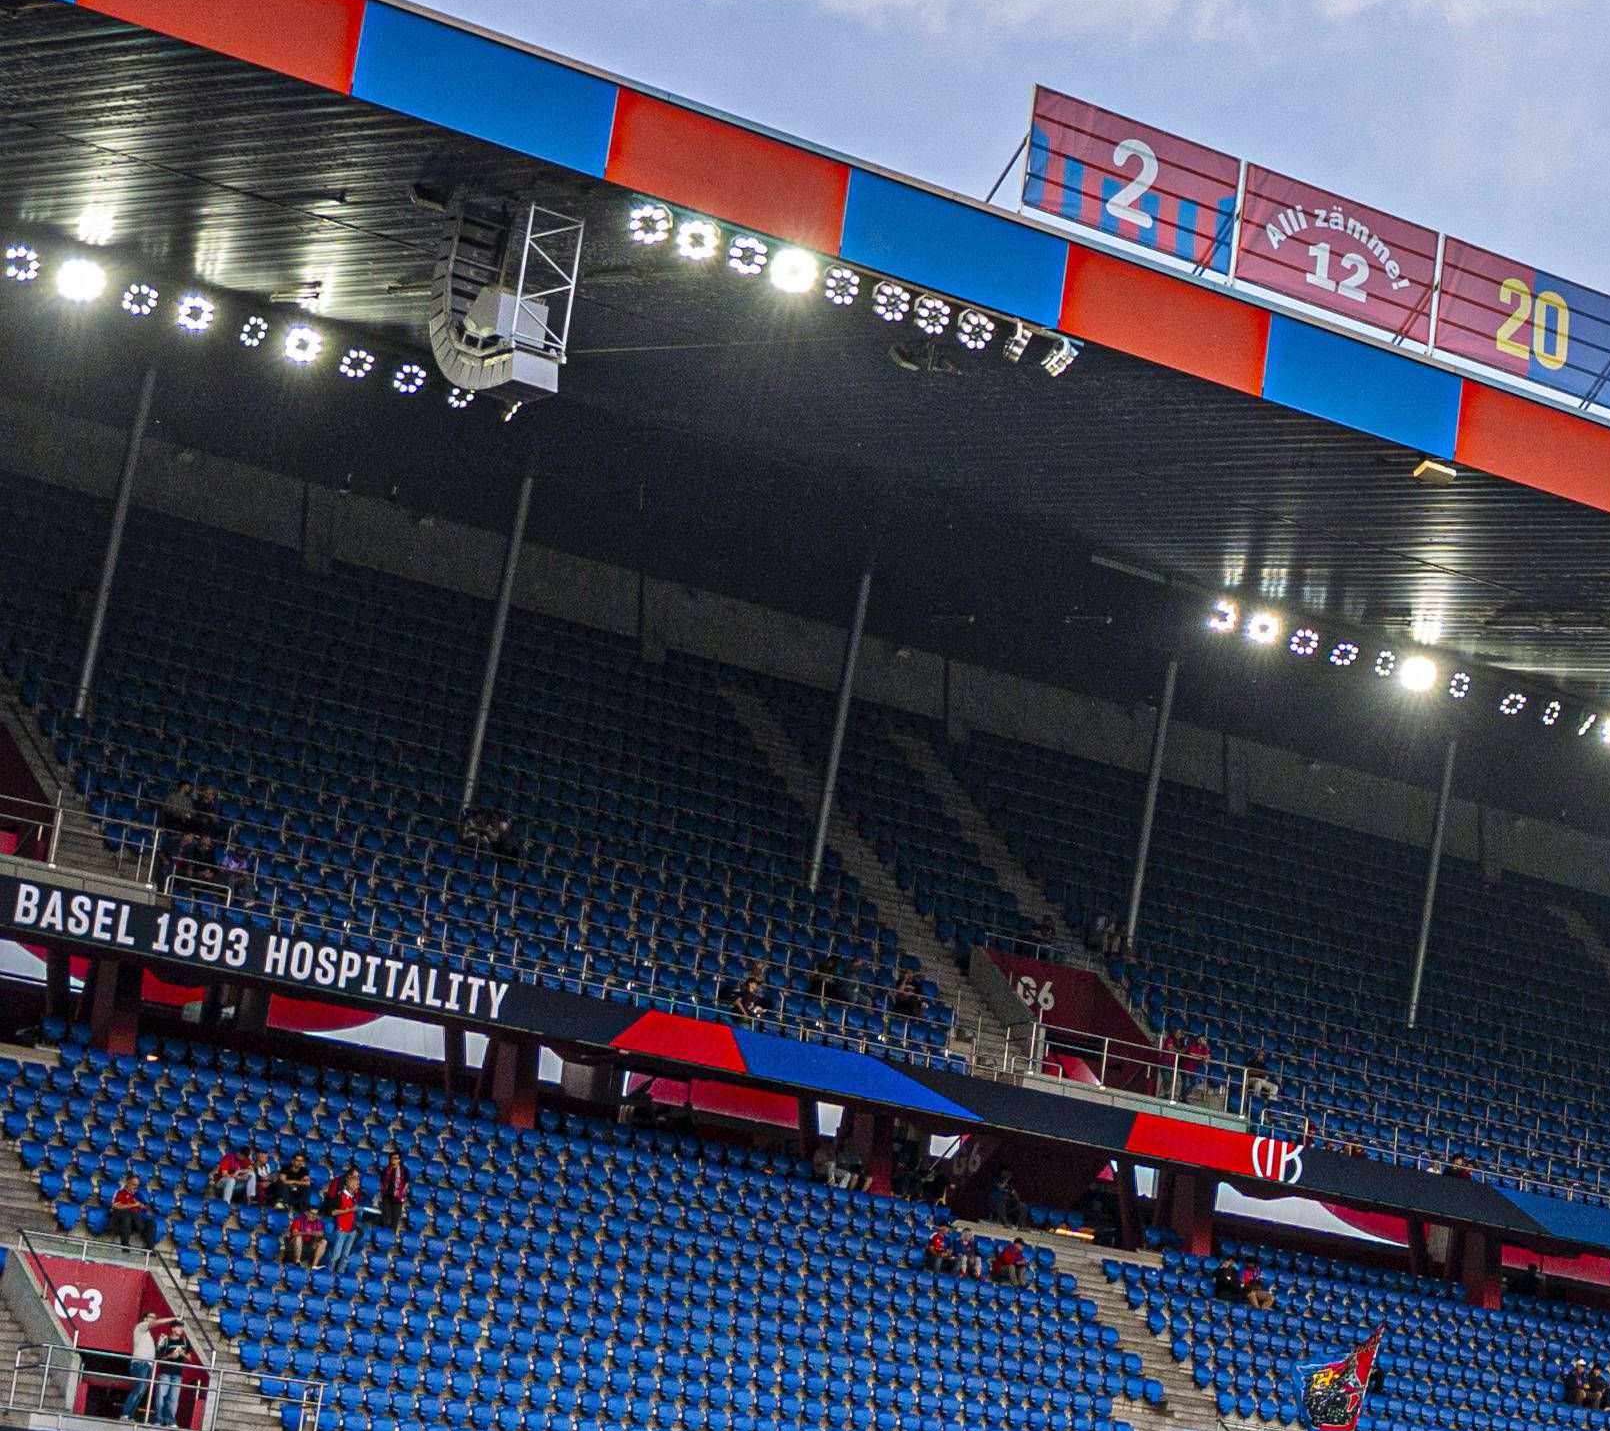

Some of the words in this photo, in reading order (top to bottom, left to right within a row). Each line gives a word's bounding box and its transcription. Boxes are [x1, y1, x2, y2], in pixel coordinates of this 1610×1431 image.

[1105, 138, 1160, 229] 2
[1264, 205, 1309, 251] Alli
[1313, 204, 1411, 293] zämme!
[1305, 240, 1370, 305] 12
[1495, 277, 1571, 371] 20
[13, 882, 135, 948] BASEL
[152, 911, 250, 969] 1893
[264, 933, 510, 1020] HOSPITALITY
[54, 1284, 104, 1323] C3
